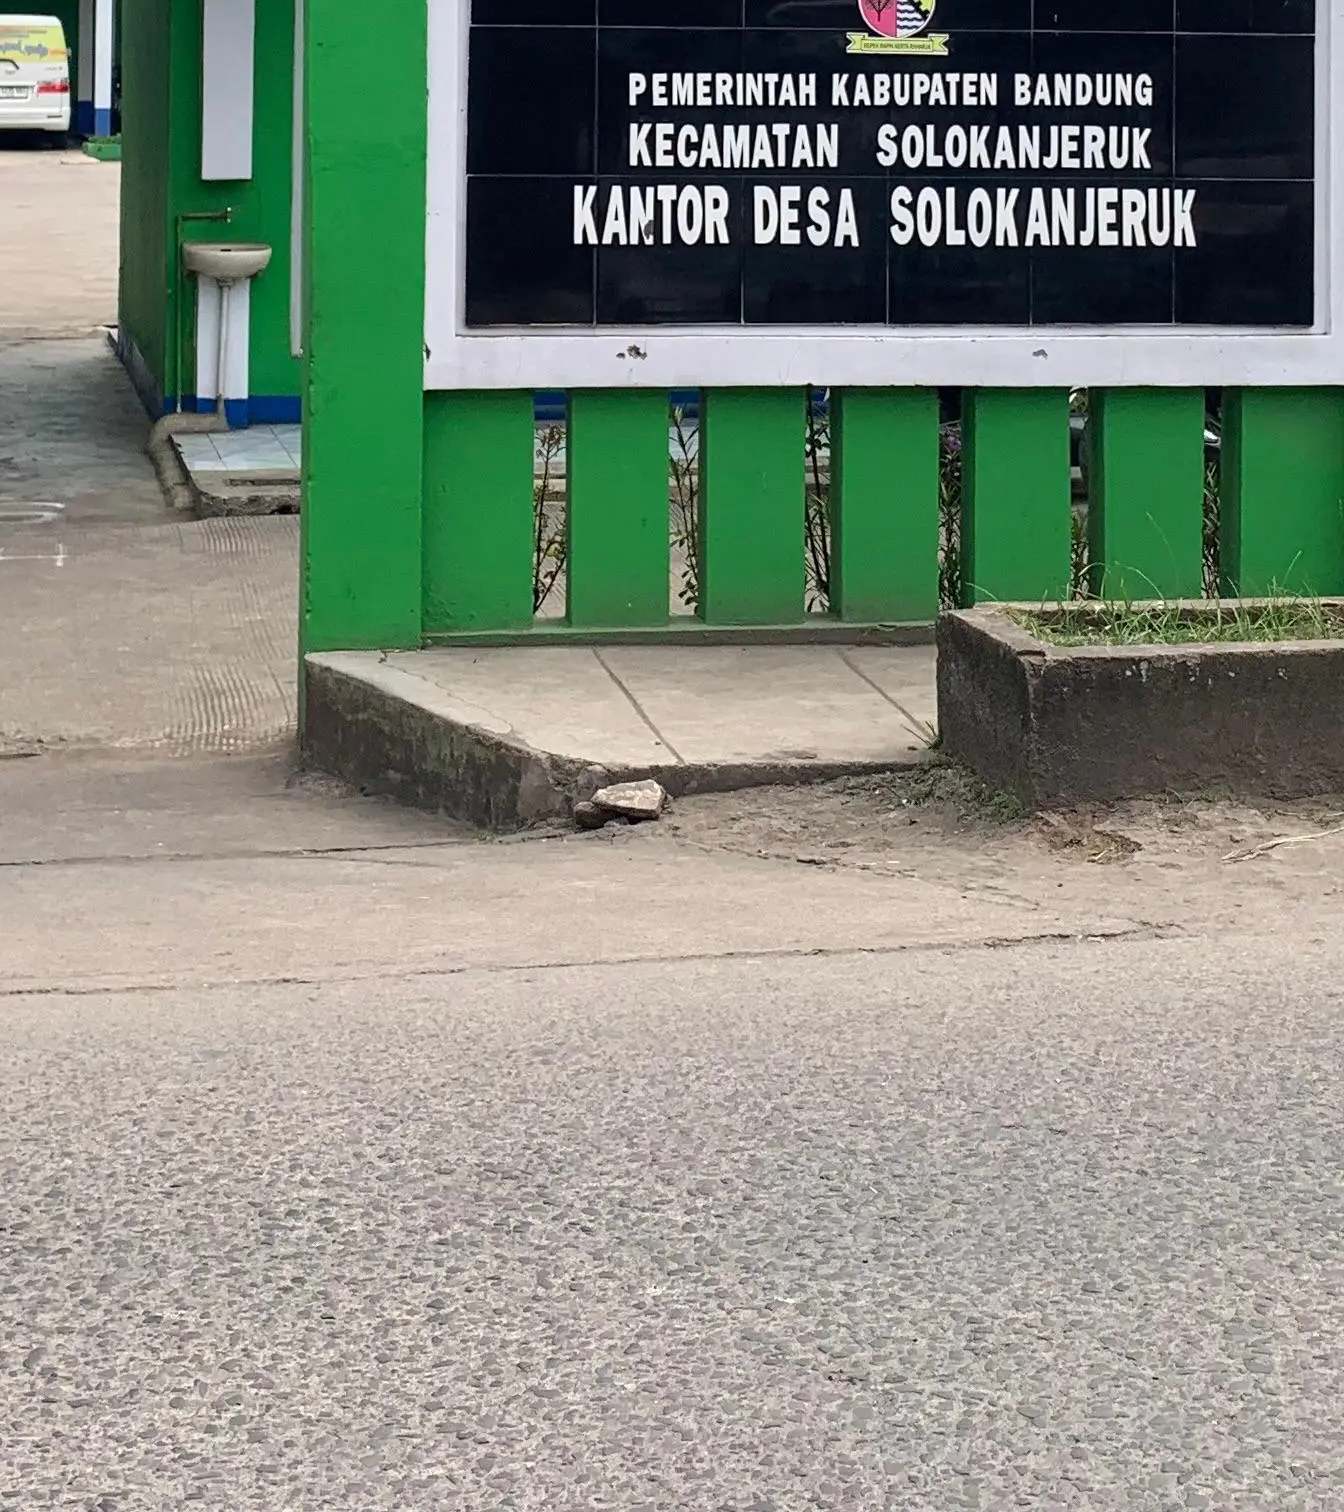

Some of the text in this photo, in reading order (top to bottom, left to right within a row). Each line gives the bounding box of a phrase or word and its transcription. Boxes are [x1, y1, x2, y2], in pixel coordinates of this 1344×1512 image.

[629, 73, 1154, 107] PEMERINTAH KABUPATEN BANDUNG
[630, 123, 1152, 170] KECAMATAN SOLOKANJERUK
[573, 184, 1197, 248] KANTOR DESA SOLOKANJERUK
